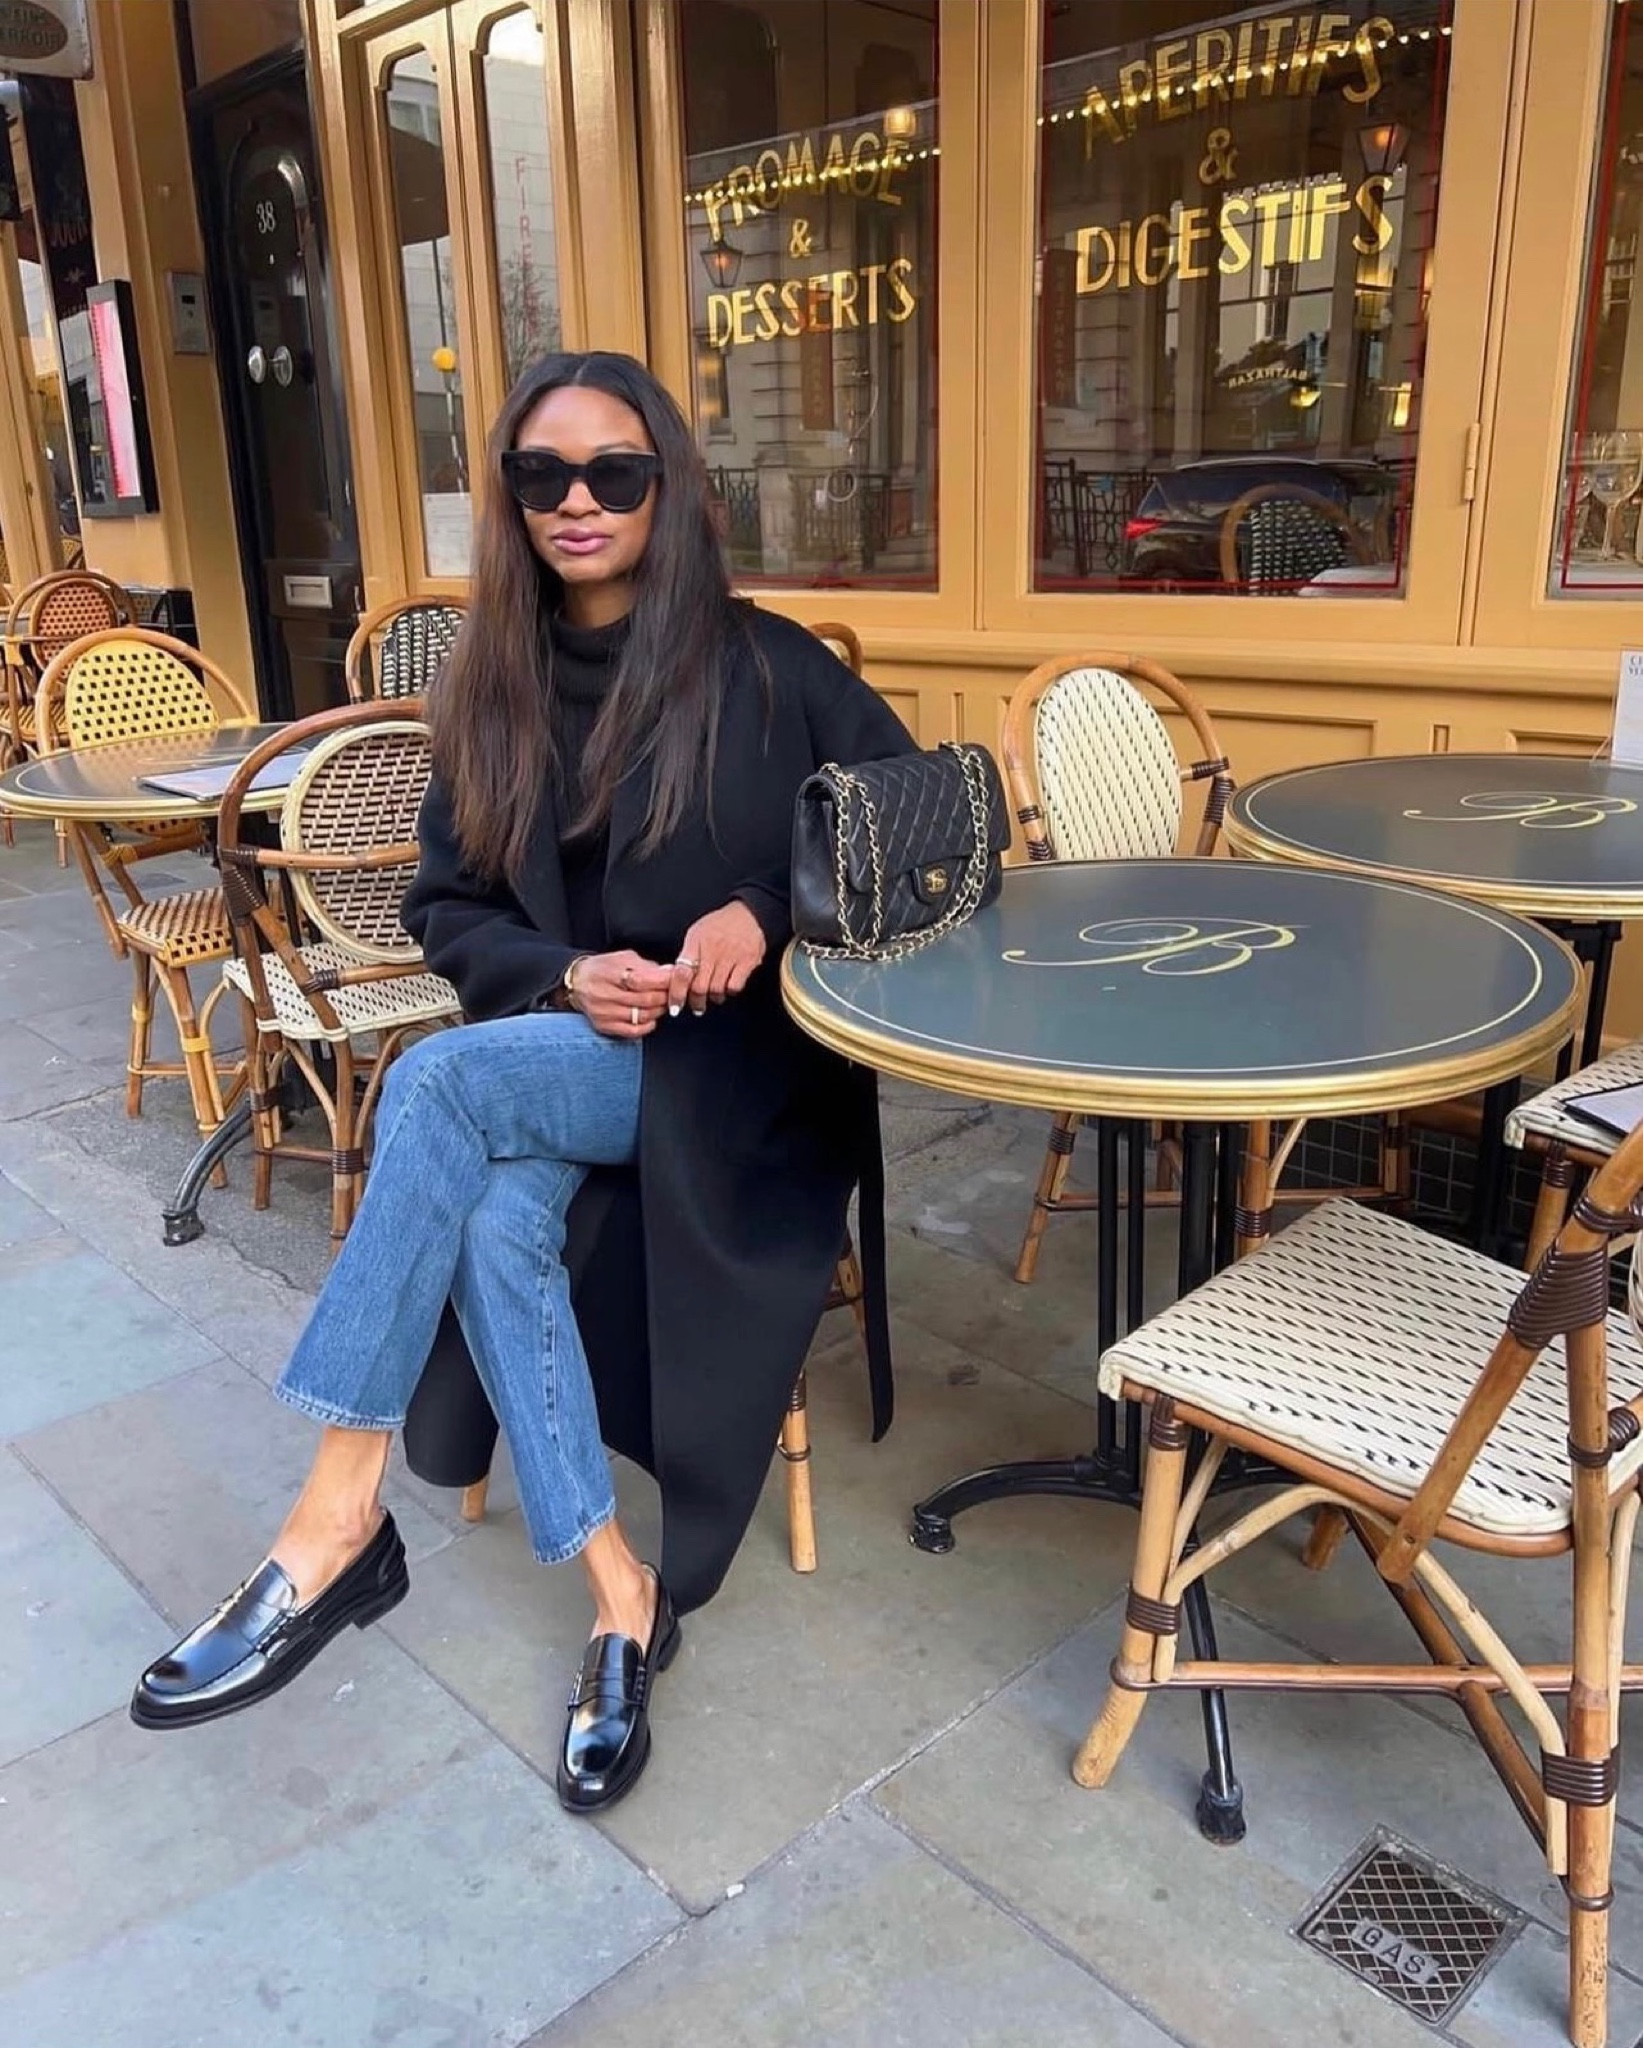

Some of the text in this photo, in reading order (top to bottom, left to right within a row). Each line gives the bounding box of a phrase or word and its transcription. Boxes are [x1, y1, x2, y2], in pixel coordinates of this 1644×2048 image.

[1083, 14, 1395, 161] APERITIFS
[703, 132, 910, 243] FROMAGE
[1199, 127, 1238, 186] &
[255, 200, 276, 234] 38
[790, 218, 812, 259] &
[1075, 174, 1394, 295] DIGESTIFS
[707, 258, 916, 348] DESSERTS
[1361, 1927, 1427, 1976] GAS
